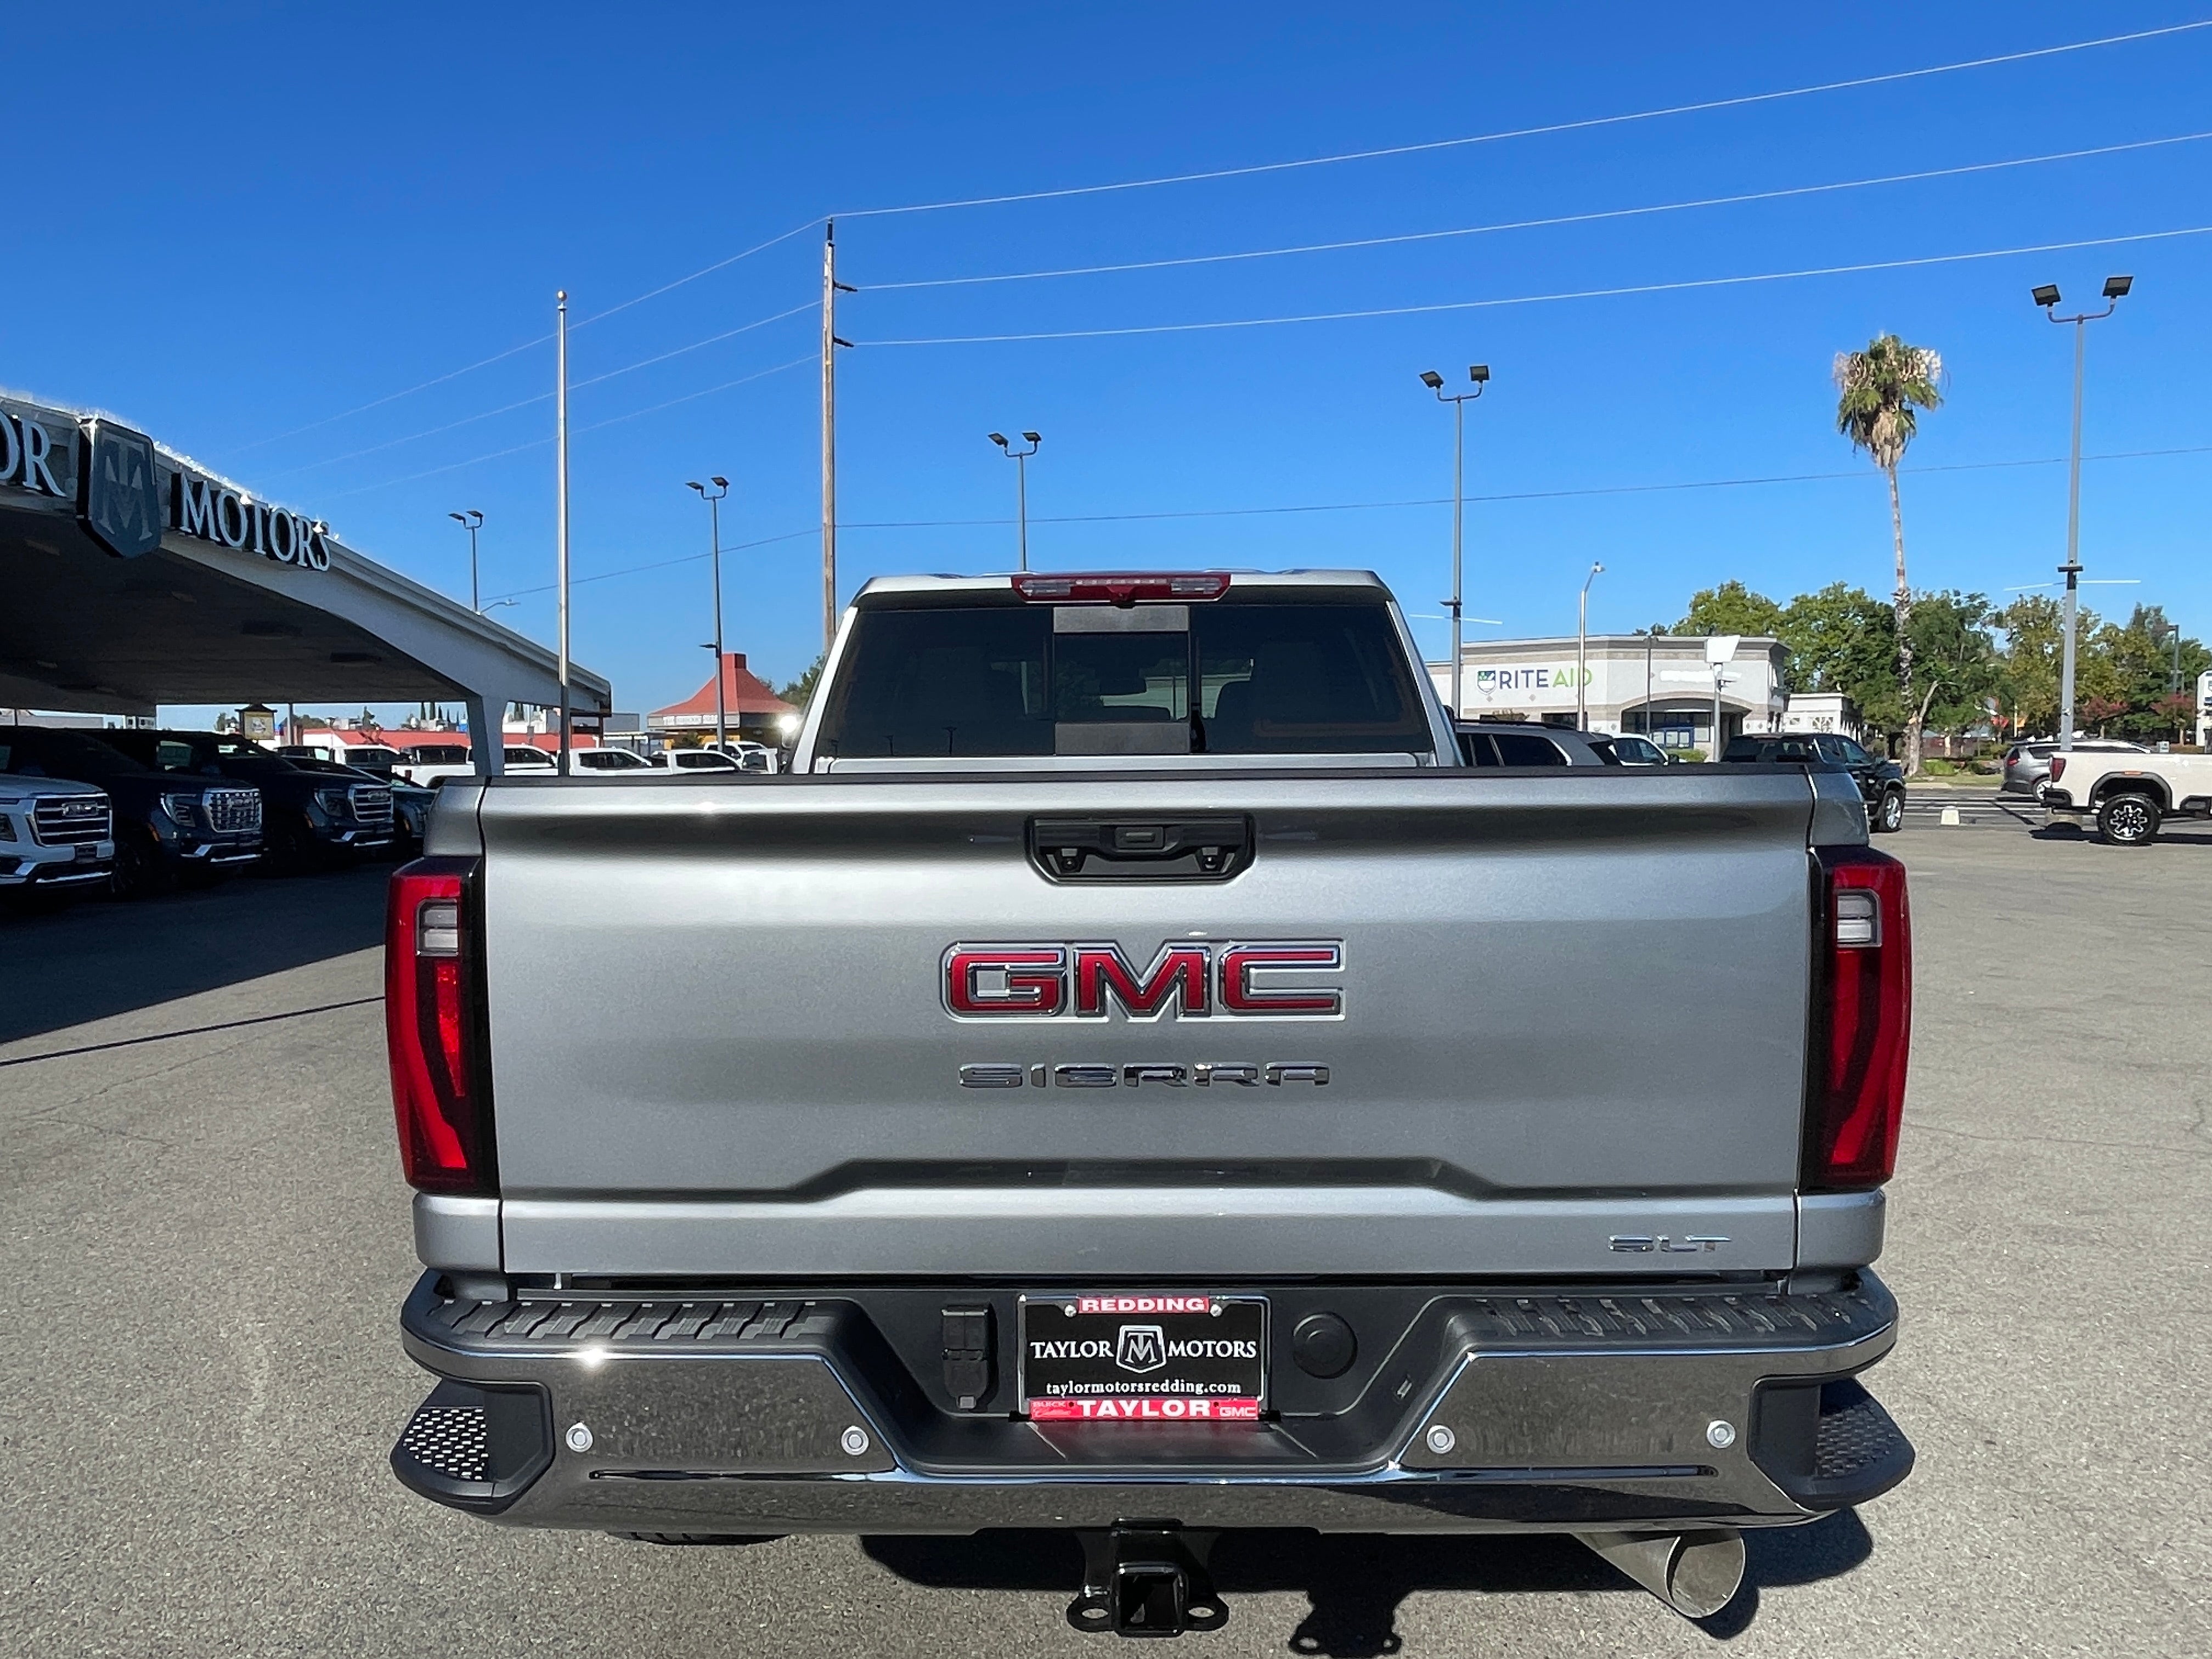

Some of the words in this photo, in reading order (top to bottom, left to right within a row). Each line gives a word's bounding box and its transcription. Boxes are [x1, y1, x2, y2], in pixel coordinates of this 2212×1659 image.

[179, 471, 330, 572] MOTORS
[1499, 669, 1549, 690] RITE
[1553, 667, 1592, 687] AID
[940, 940, 1345, 1022] GMC
[959, 1062, 1330, 1088] SIERRA
[1609, 1235, 1732, 1252] SLT
[1081, 1299, 1205, 1311] REDDING
[1030, 1341, 1114, 1358] TAYLOR
[1167, 1340, 1257, 1358] MOTORS
[1046, 1380, 1242, 1398] taylormotorsredding.com
[1077, 1400, 1211, 1417] TAYLOR
[1219, 1407, 1256, 1416] GMC
